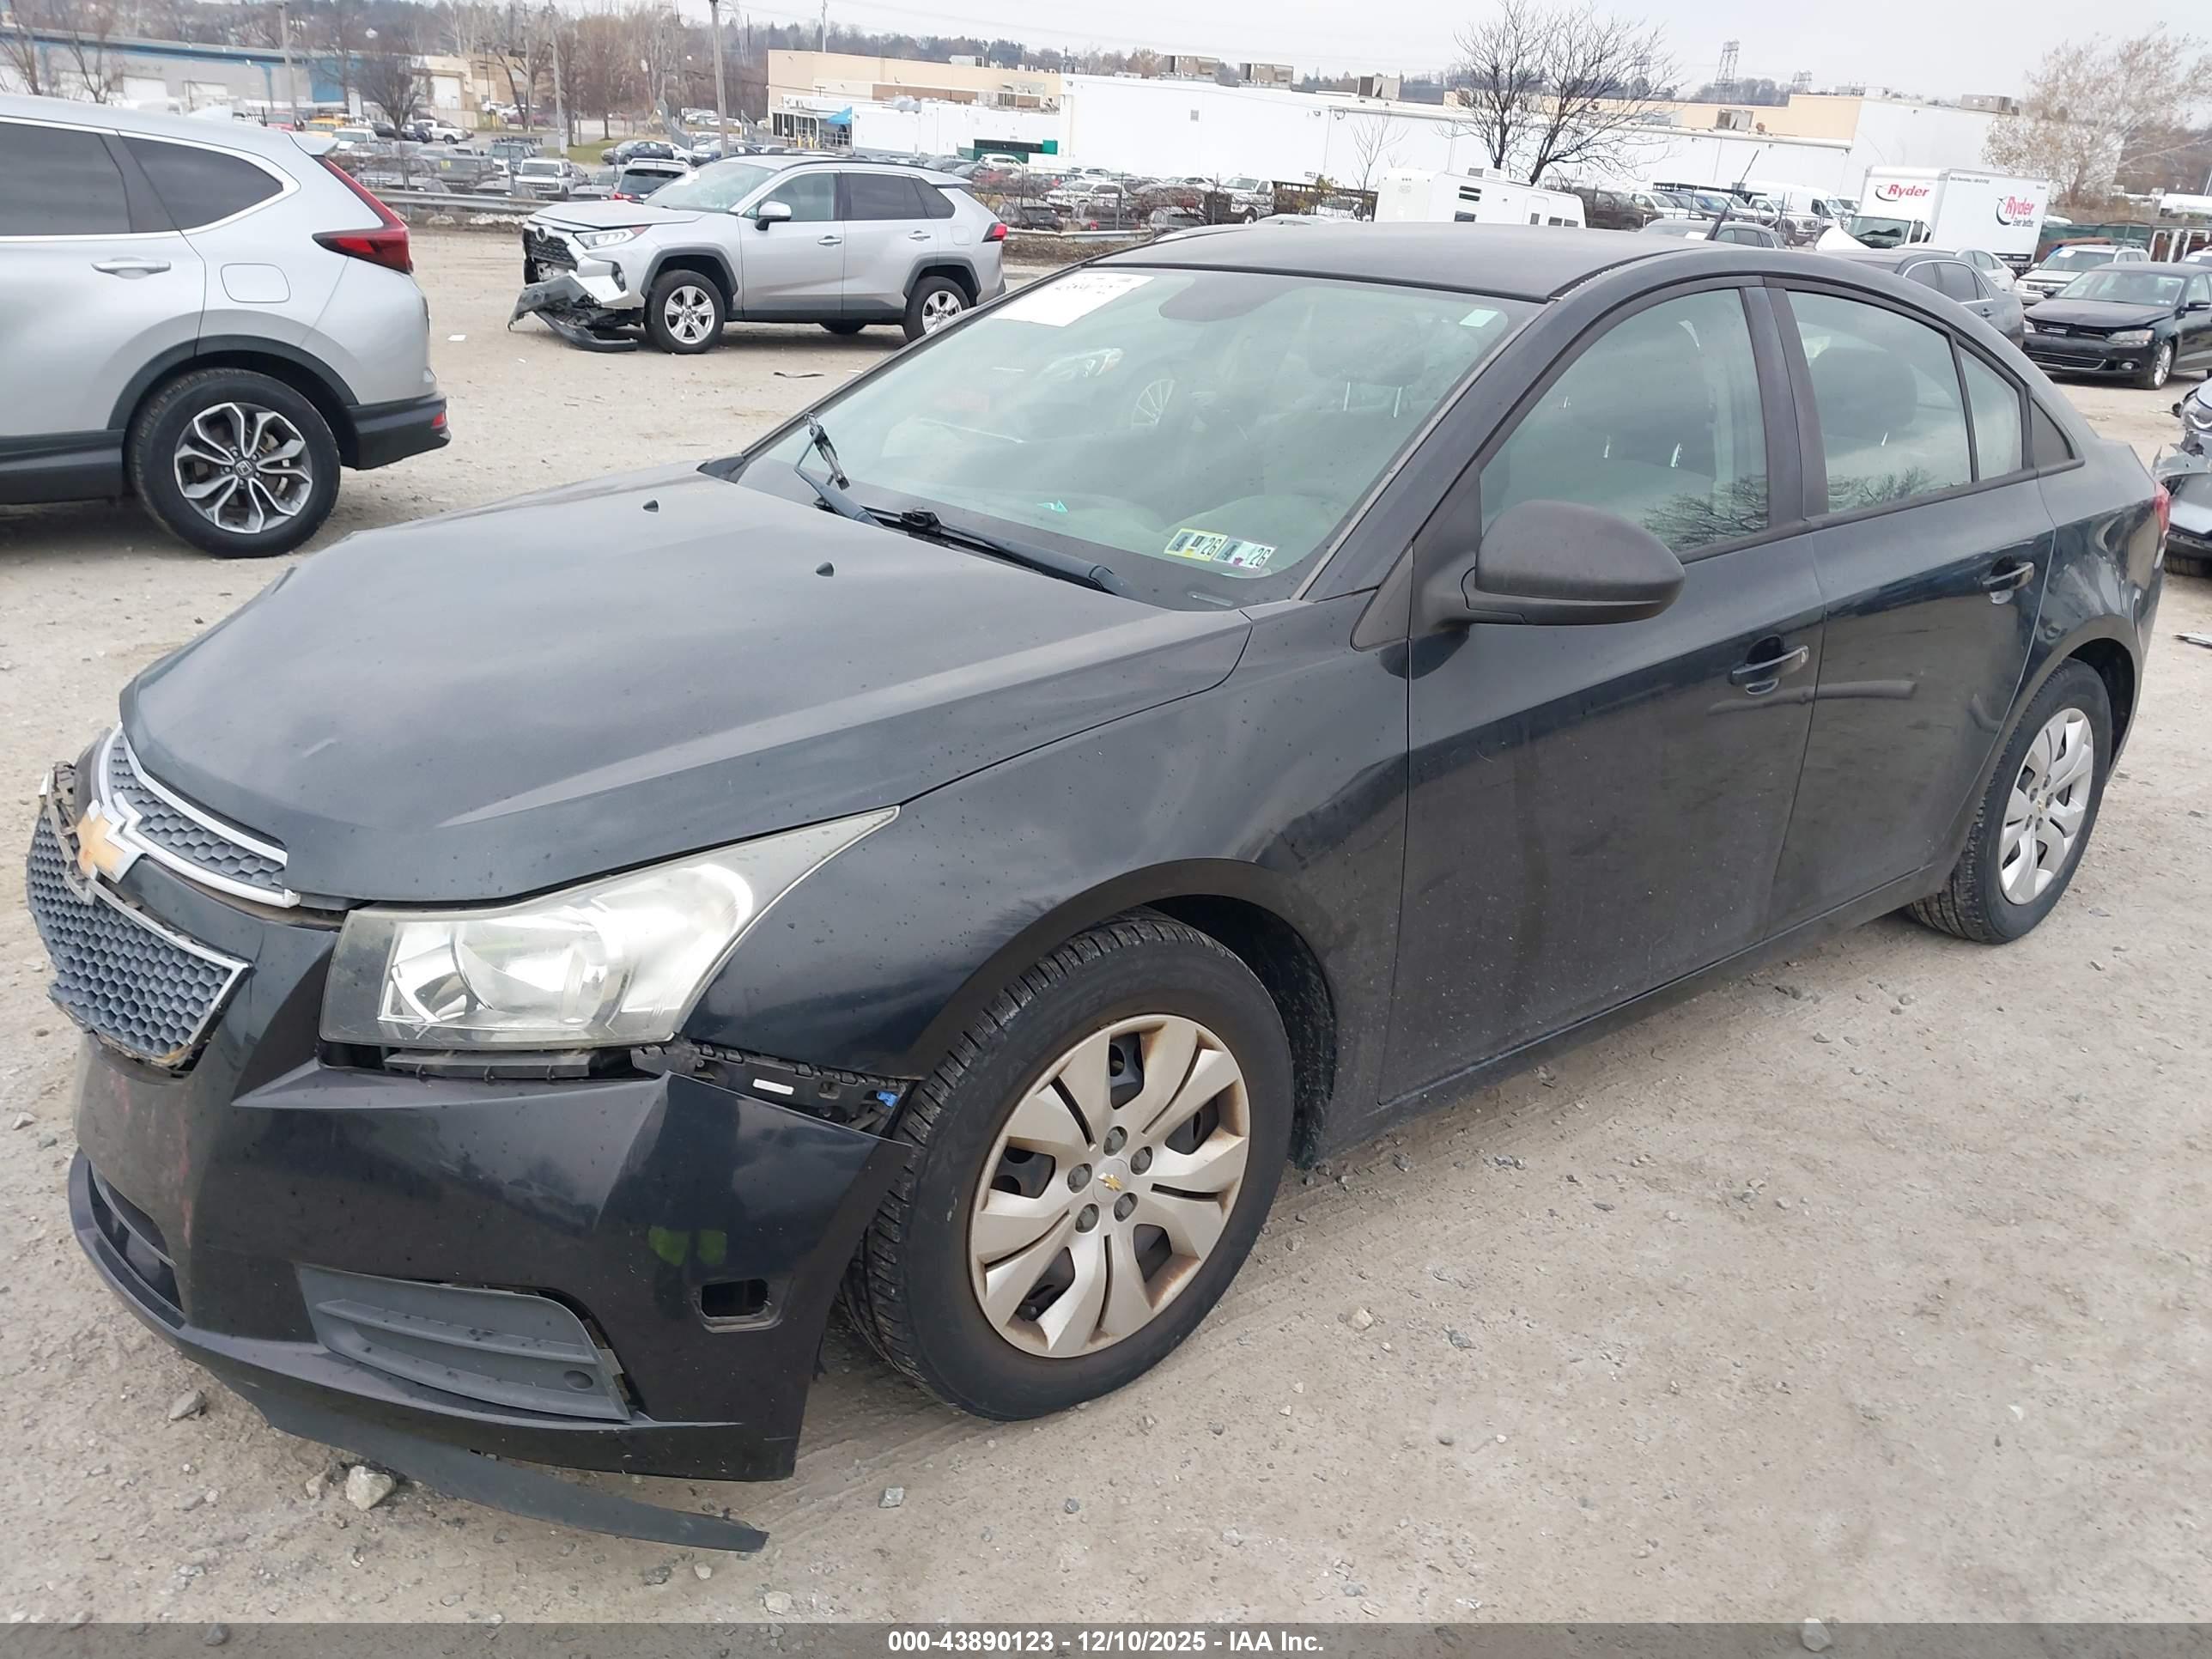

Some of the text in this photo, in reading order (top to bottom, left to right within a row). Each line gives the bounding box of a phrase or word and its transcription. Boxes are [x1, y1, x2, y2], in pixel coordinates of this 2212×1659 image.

[1887, 184, 1929, 198] Ryder
[2005, 196, 2034, 219] Ryder
[1200, 537, 1222, 556] 26
[1249, 547, 1271, 567] 26
